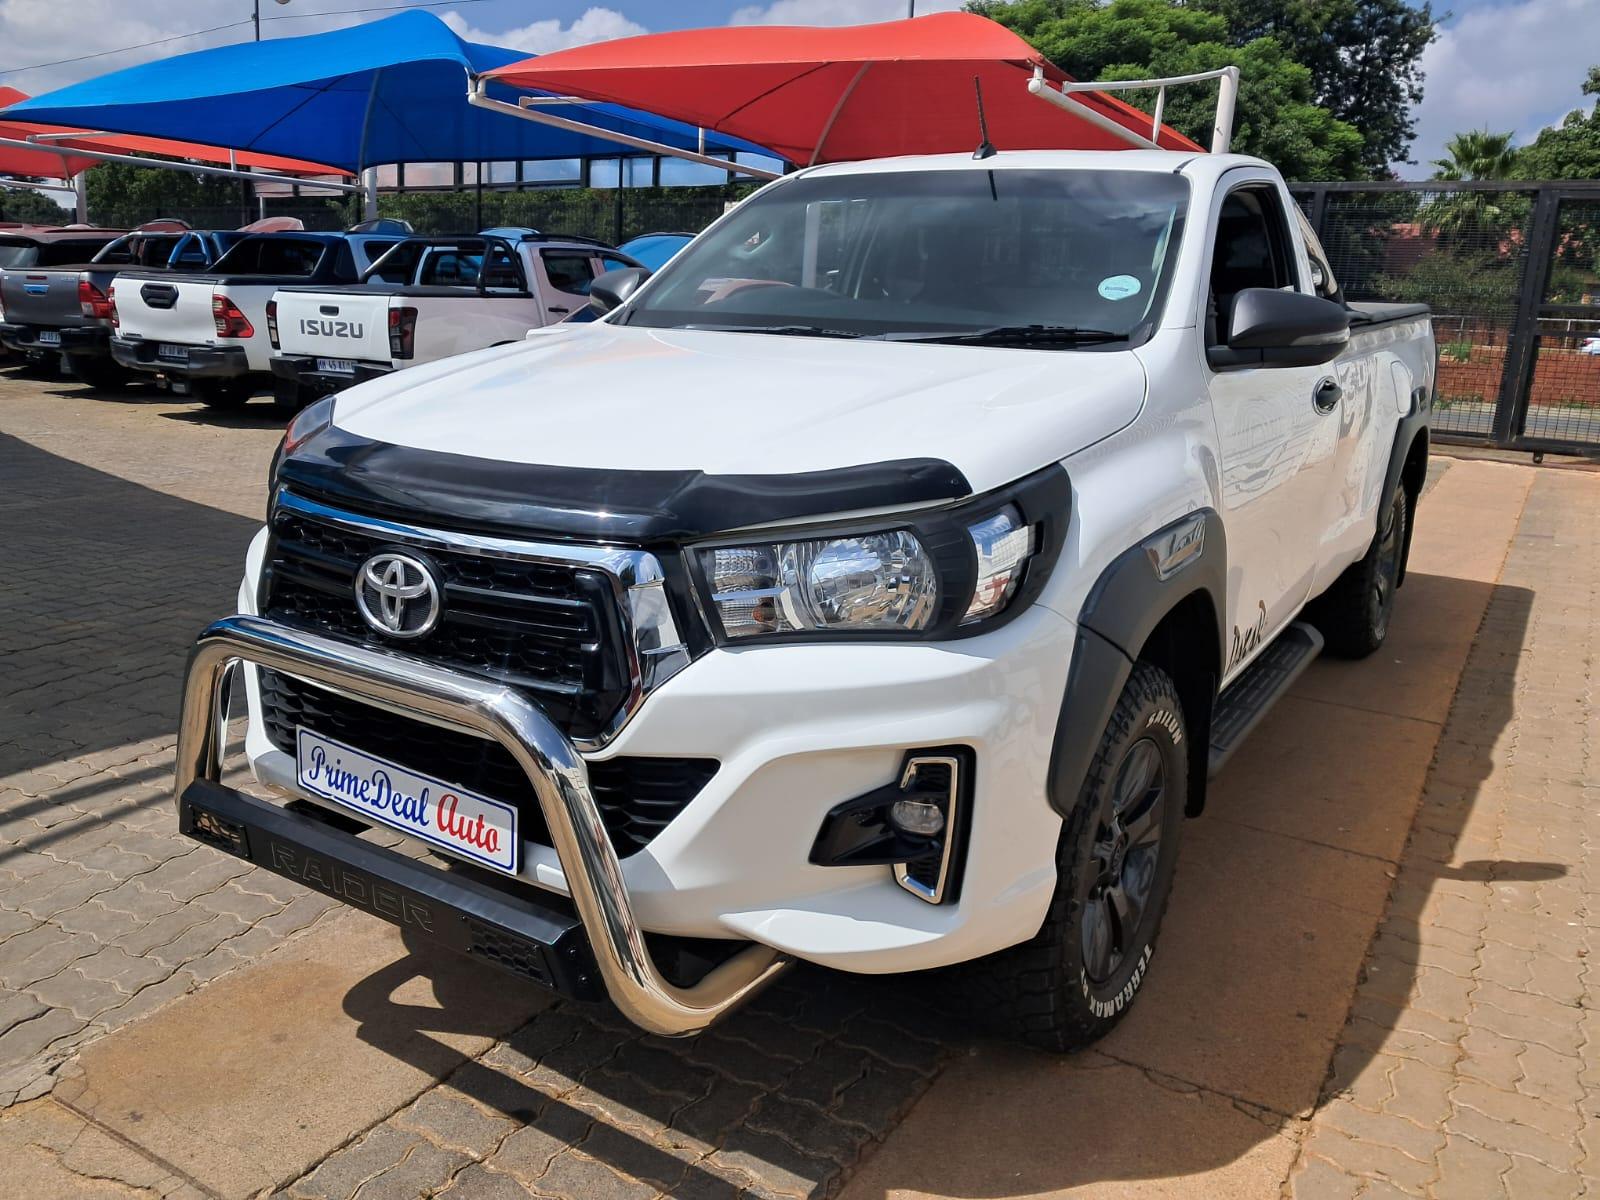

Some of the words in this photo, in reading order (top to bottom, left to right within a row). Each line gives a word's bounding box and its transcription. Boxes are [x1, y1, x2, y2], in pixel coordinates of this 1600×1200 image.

[300, 319, 364, 339] ISUZU
[1145, 710, 1183, 745] SAILUN
[309, 745, 430, 827] PrimeDeal
[436, 793, 502, 854] Auto
[271, 841, 434, 934] RAIDER
[1089, 943, 1153, 1019] TERRAMAX
